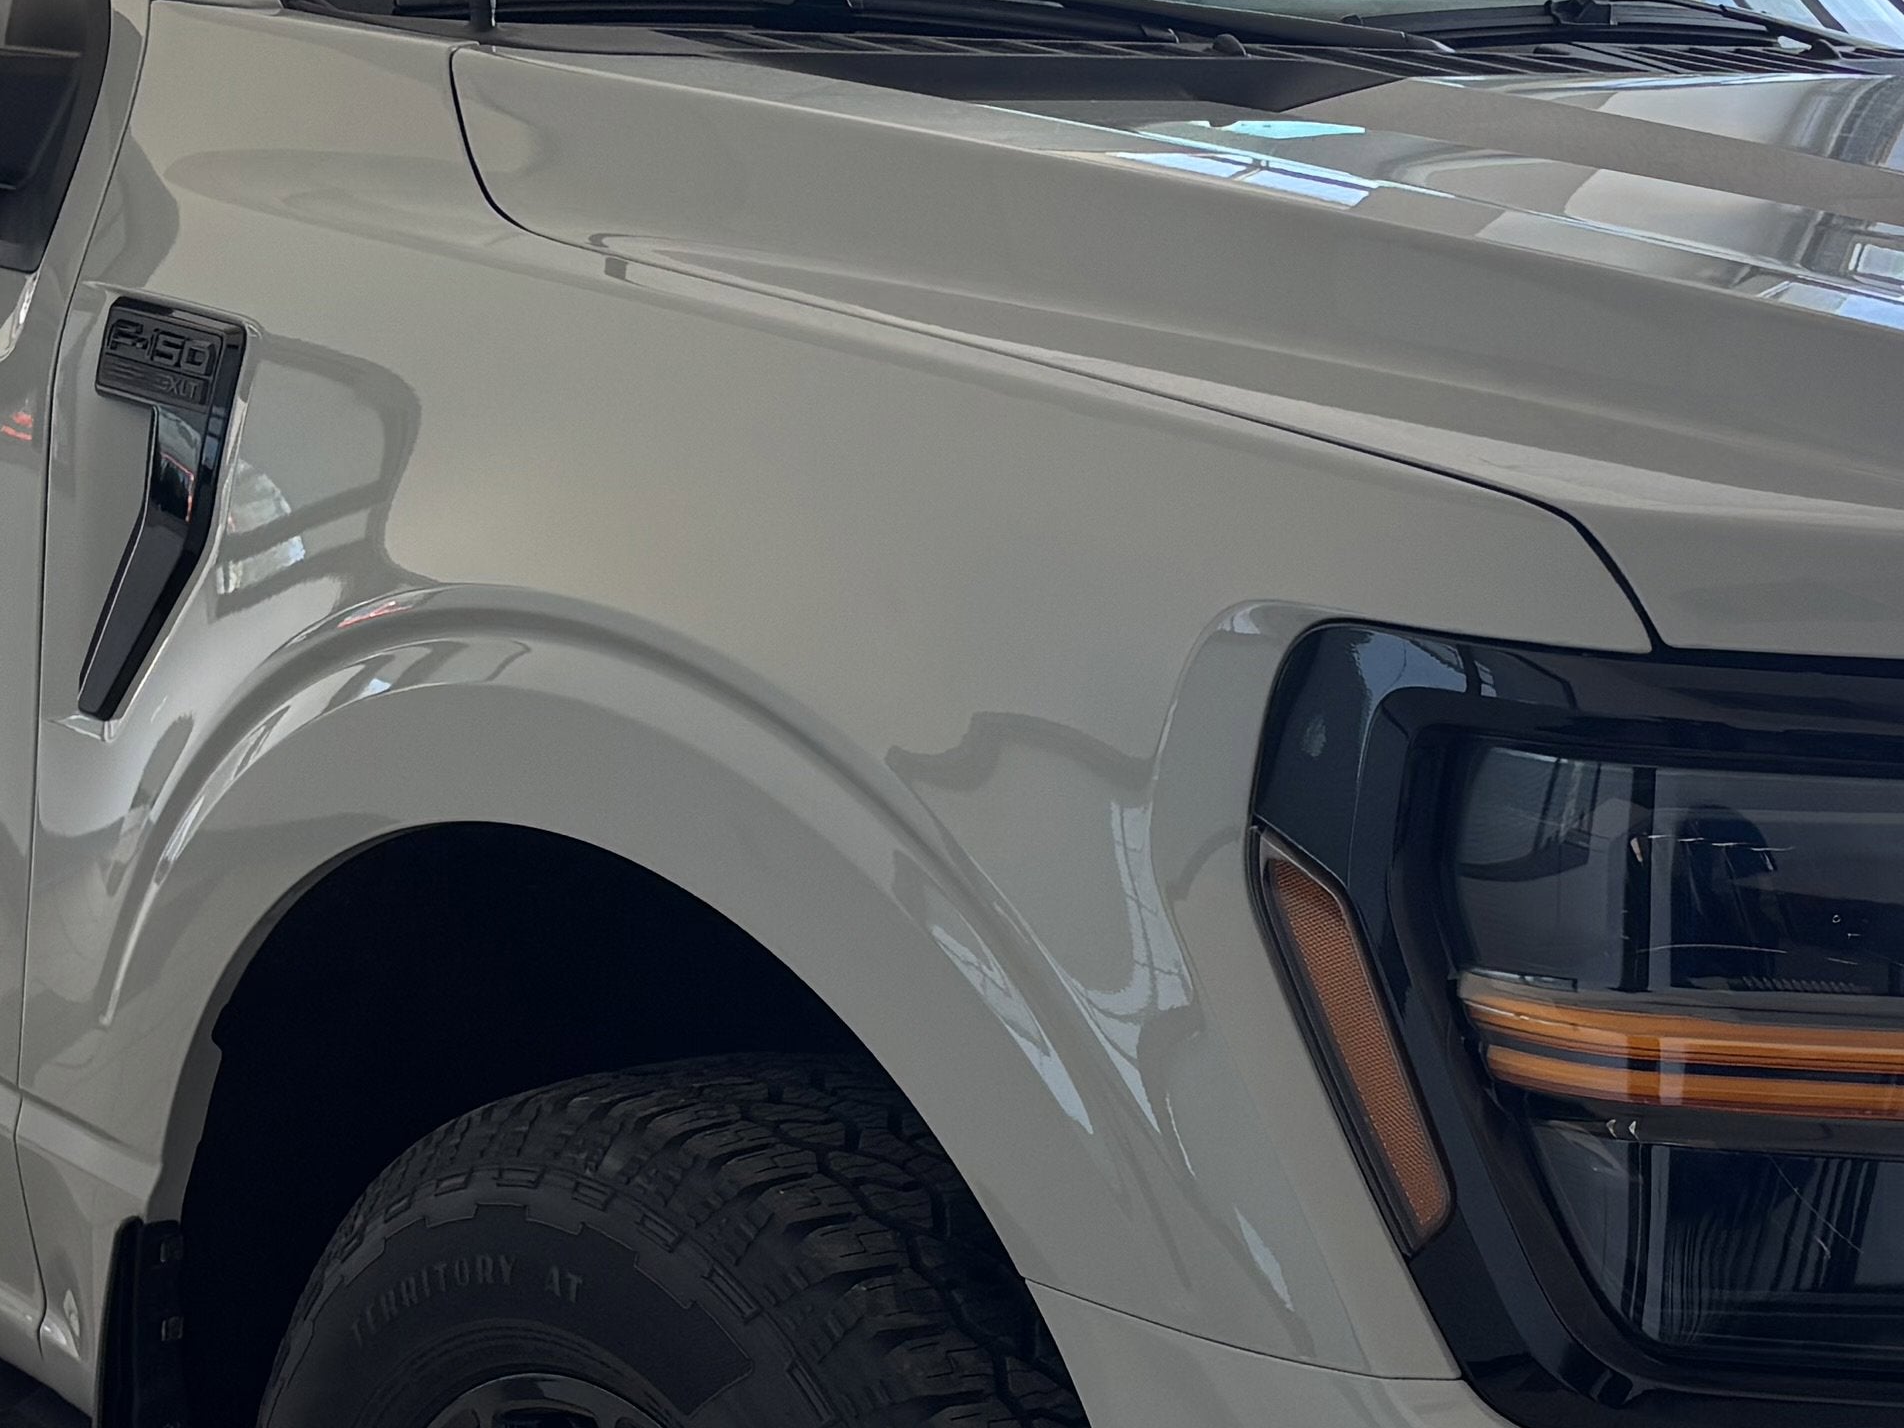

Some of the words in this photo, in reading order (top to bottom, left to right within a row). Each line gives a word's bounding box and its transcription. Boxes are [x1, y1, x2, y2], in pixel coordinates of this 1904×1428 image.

[107, 319, 216, 376] F-150
[167, 375, 200, 399] XLT
[350, 1254, 519, 1347] TERRITORY
[544, 1264, 585, 1304] AT
